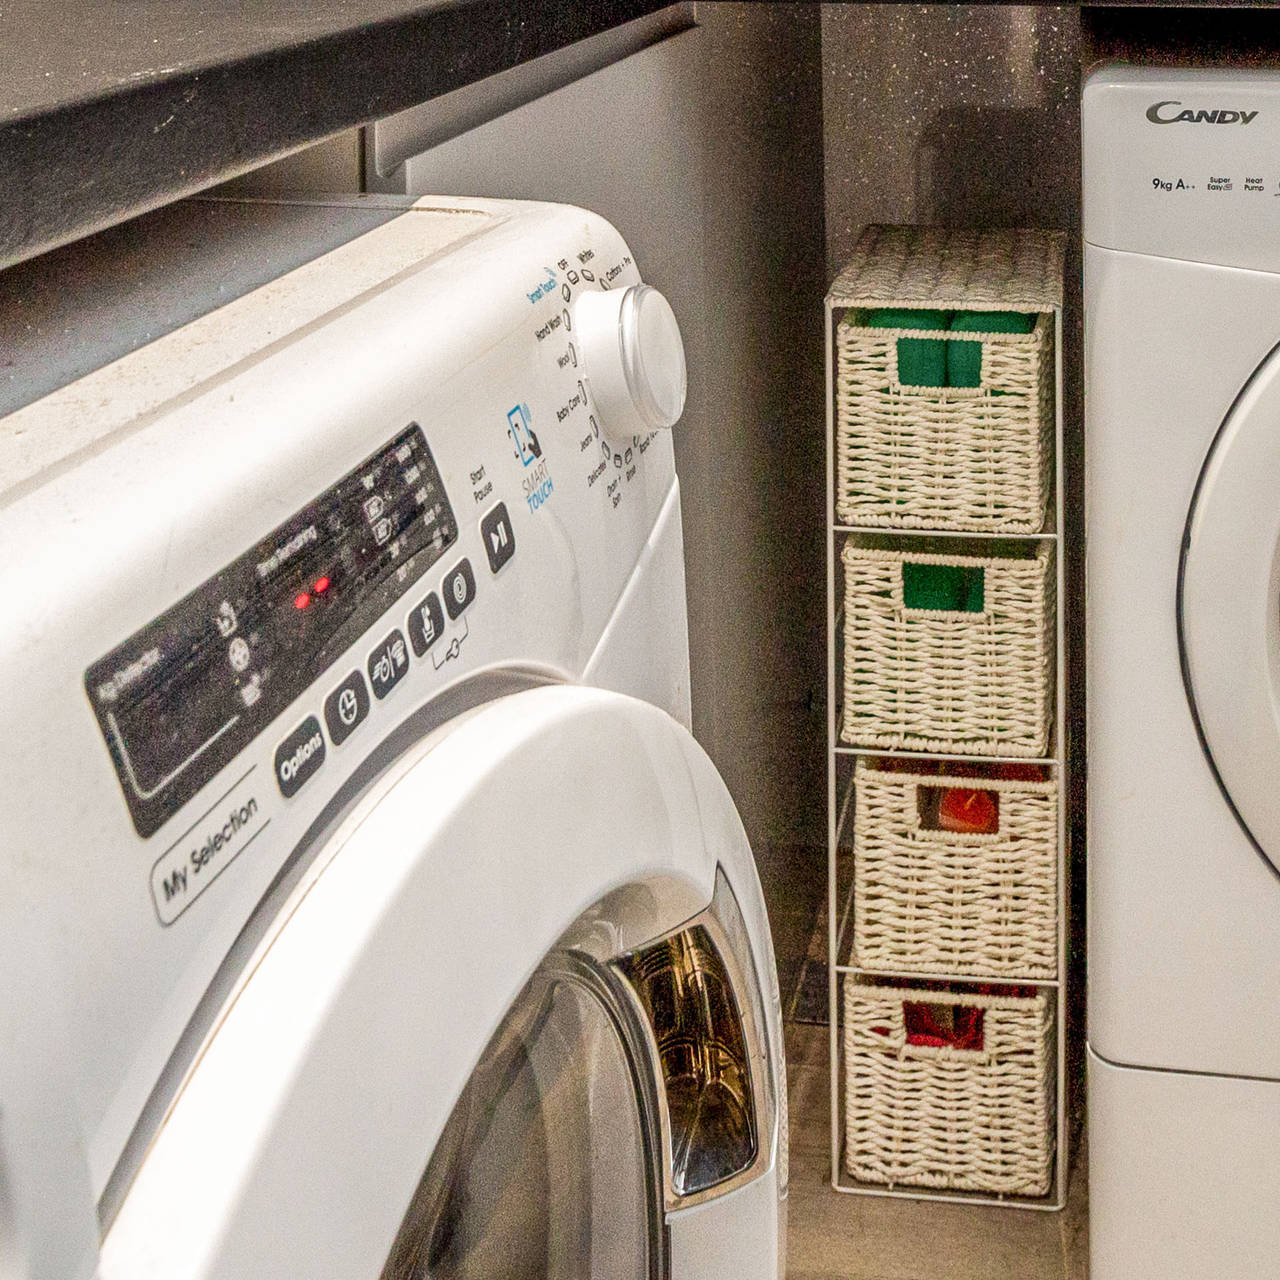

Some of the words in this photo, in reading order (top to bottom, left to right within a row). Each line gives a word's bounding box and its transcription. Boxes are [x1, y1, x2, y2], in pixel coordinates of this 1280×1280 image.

[1152, 178, 1172, 191] 9kg
[1208, 183, 1224, 191] Easy
[1244, 184, 1264, 192] Pump
[473, 481, 493, 504] Pause
[522, 458, 549, 499] SMART
[527, 476, 555, 515] TOUCH
[280, 732, 322, 782] Options
[162, 865, 188, 902] My
[190, 796, 259, 874] Selection
